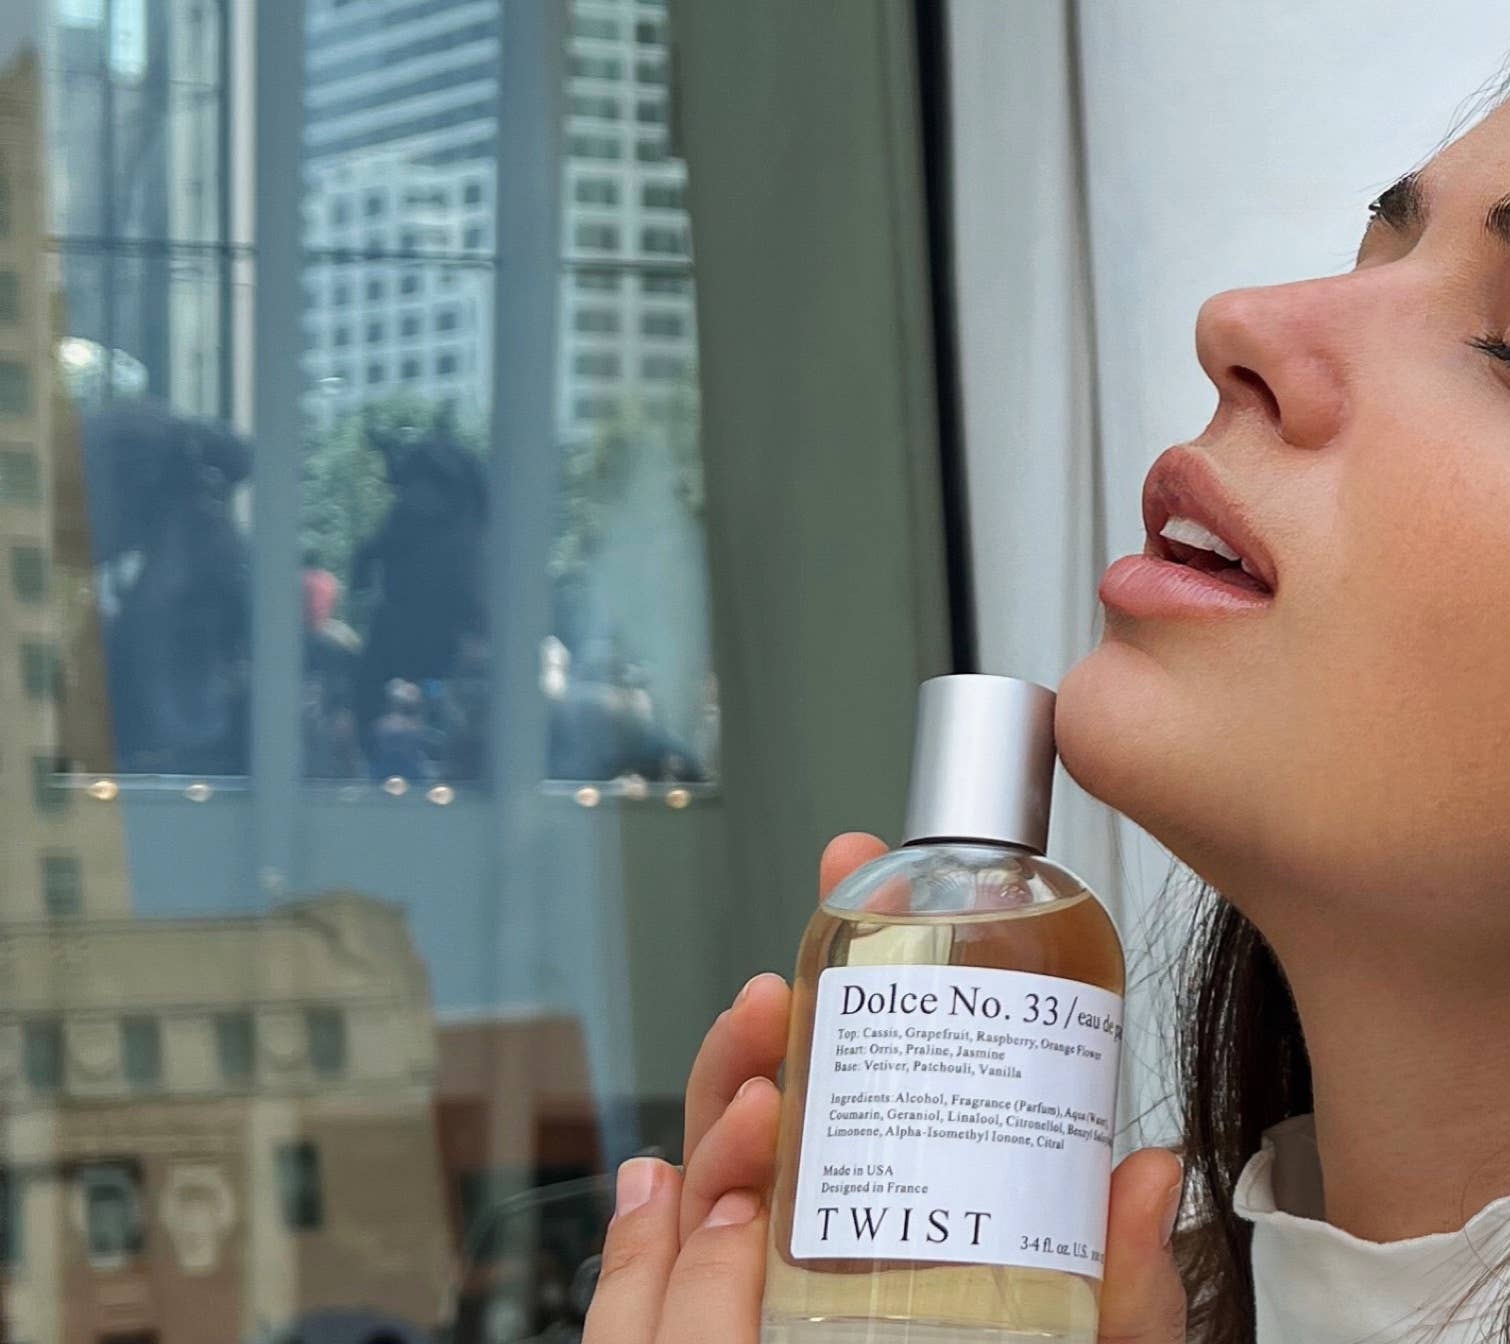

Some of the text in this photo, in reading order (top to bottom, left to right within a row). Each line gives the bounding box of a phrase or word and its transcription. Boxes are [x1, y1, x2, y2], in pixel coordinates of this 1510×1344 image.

[840, 982, 938, 1015] Dolce
[948, 985, 1010, 1020] No.
[863, 1027, 902, 1039] Cassis,
[905, 1027, 973, 1042] Grapefruit,
[976, 1031, 1039, 1050] Raspberry,
[1041, 1038, 1076, 1056] Orange
[869, 1043, 903, 1056] Orris,
[905, 1044, 954, 1058] Praline,
[956, 1046, 1006, 1060] Jasmine
[864, 1060, 909, 1073] Vetiver,
[912, 1060, 975, 1075] Patchouli,
[979, 1064, 1022, 1078] Vanilla
[895, 1092, 948, 1106] Alcohol,
[951, 1094, 1012, 1109] Fragrance
[1014, 1100, 1063, 1118] (Parfum),
[829, 1109, 884, 1121] Coumarin,
[887, 1108, 944, 1124] Geraniol,
[947, 1110, 1003, 1128] Linalool,
[1006, 1115, 1065, 1136] Citronellol,
[827, 1126, 883, 1138] Limonene,
[991, 1131, 1034, 1148] Ionone,
[1037, 1135, 1065, 1150] Citral
[823, 1165, 894, 1176] Made in USA
[821, 1182, 928, 1195] Designed in France
[817, 1207, 991, 1245] TWIST
